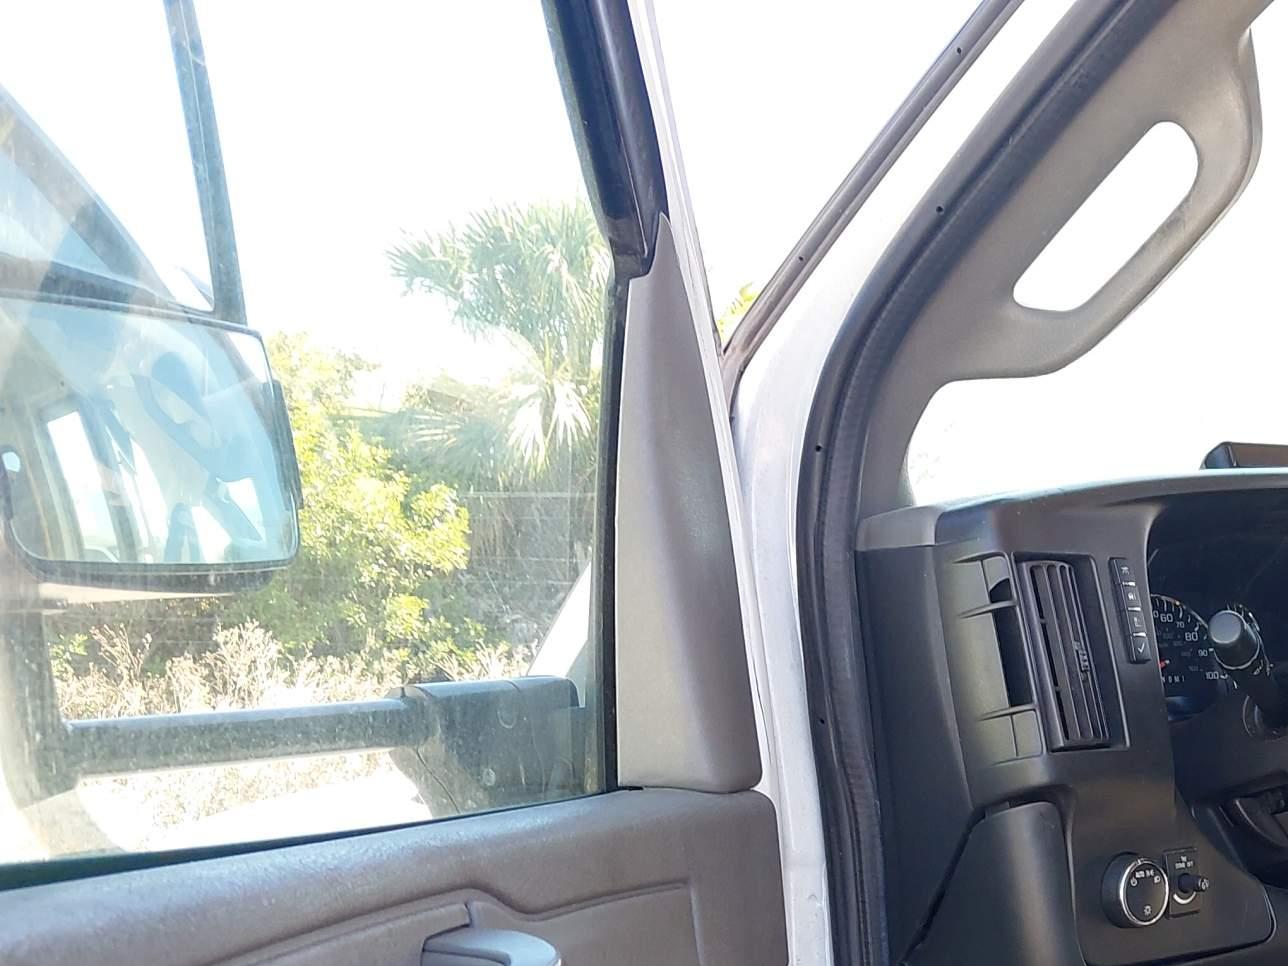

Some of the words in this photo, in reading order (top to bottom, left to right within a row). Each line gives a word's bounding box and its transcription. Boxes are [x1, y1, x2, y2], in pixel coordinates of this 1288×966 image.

[1160, 613, 1174, 623] 60
[1184, 631, 1199, 642] 80
[1198, 649, 1208, 657] 90
[1205, 671, 1220, 680] 100
